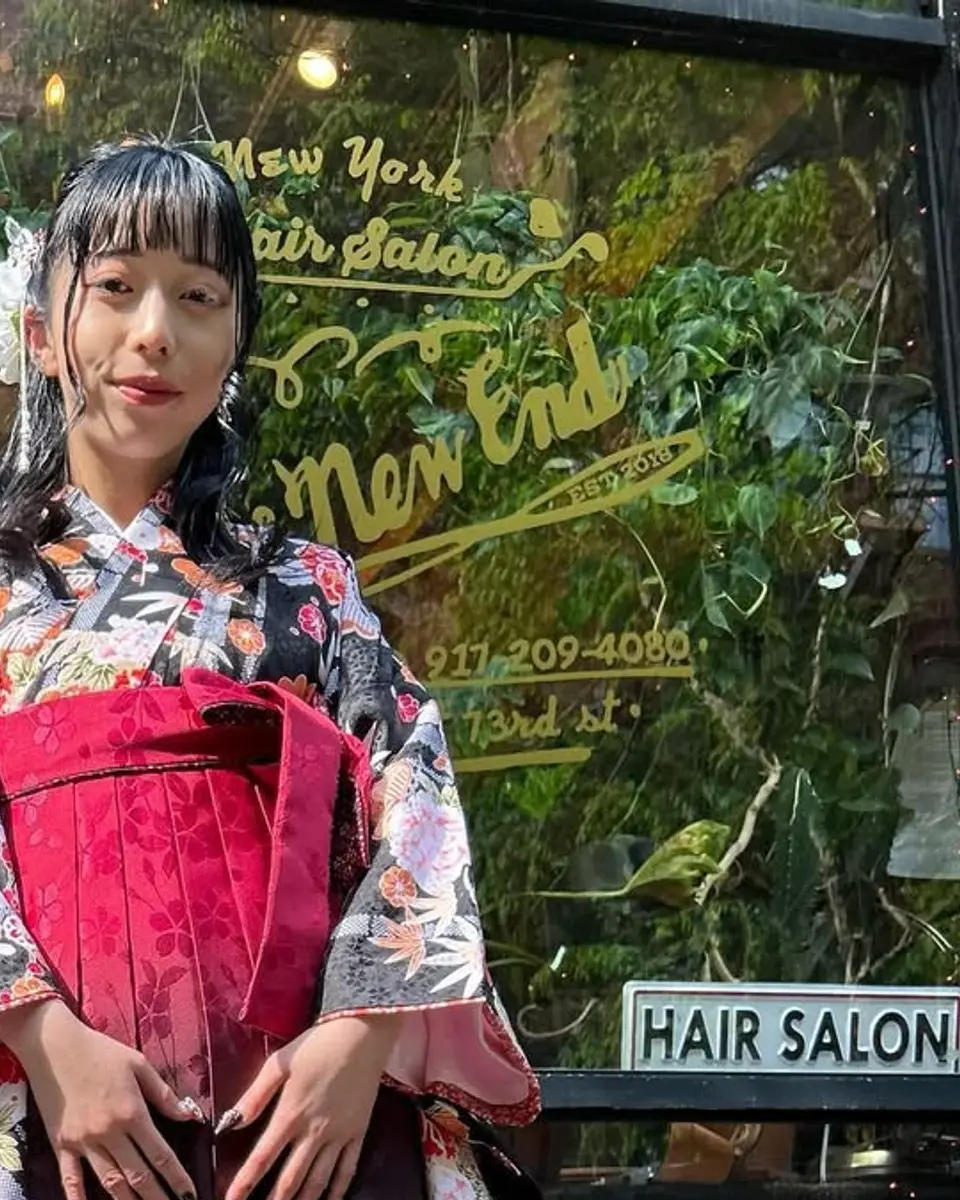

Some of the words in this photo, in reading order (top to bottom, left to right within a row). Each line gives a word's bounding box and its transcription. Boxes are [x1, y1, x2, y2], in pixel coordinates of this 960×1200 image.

[343, 135, 465, 203] York
[251, 217, 336, 264] air
[342, 217, 512, 285] Salon
[272, 428, 464, 544] New
[461, 315, 634, 466] End
[642, 1005, 762, 1062] HAIR
[778, 1009, 951, 1064] SALON
